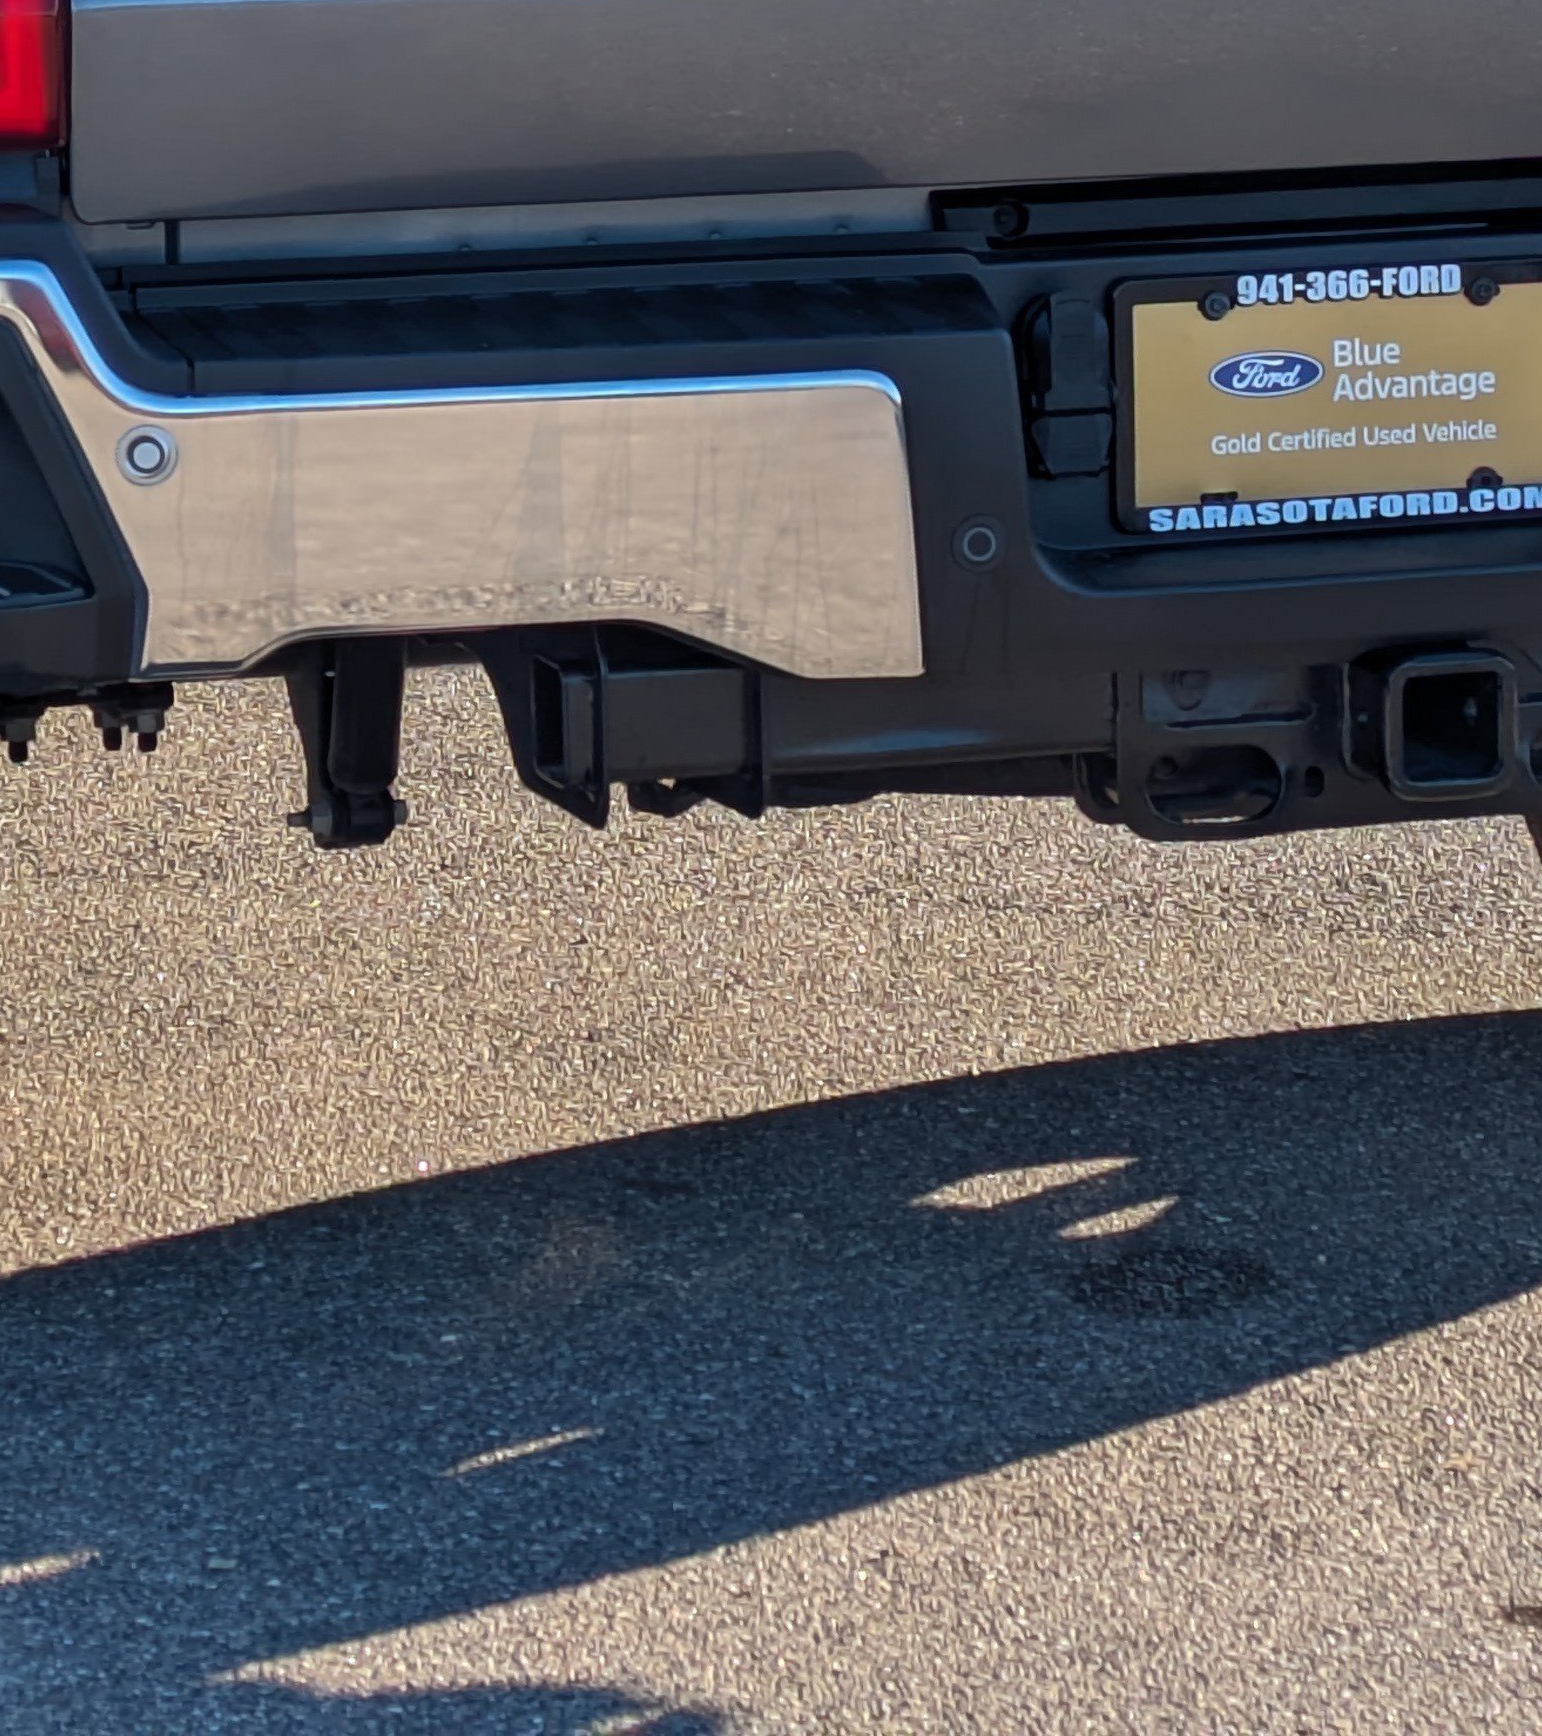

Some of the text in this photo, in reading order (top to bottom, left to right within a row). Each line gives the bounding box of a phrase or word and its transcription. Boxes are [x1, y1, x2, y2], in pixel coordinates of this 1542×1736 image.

[1236, 264, 1462, 306] 941-366-FORD
[1231, 338, 1401, 390] Ford Blue
[1332, 369, 1496, 402] Advantage
[1211, 419, 1497, 456] Gold Certified Used Vehicle
